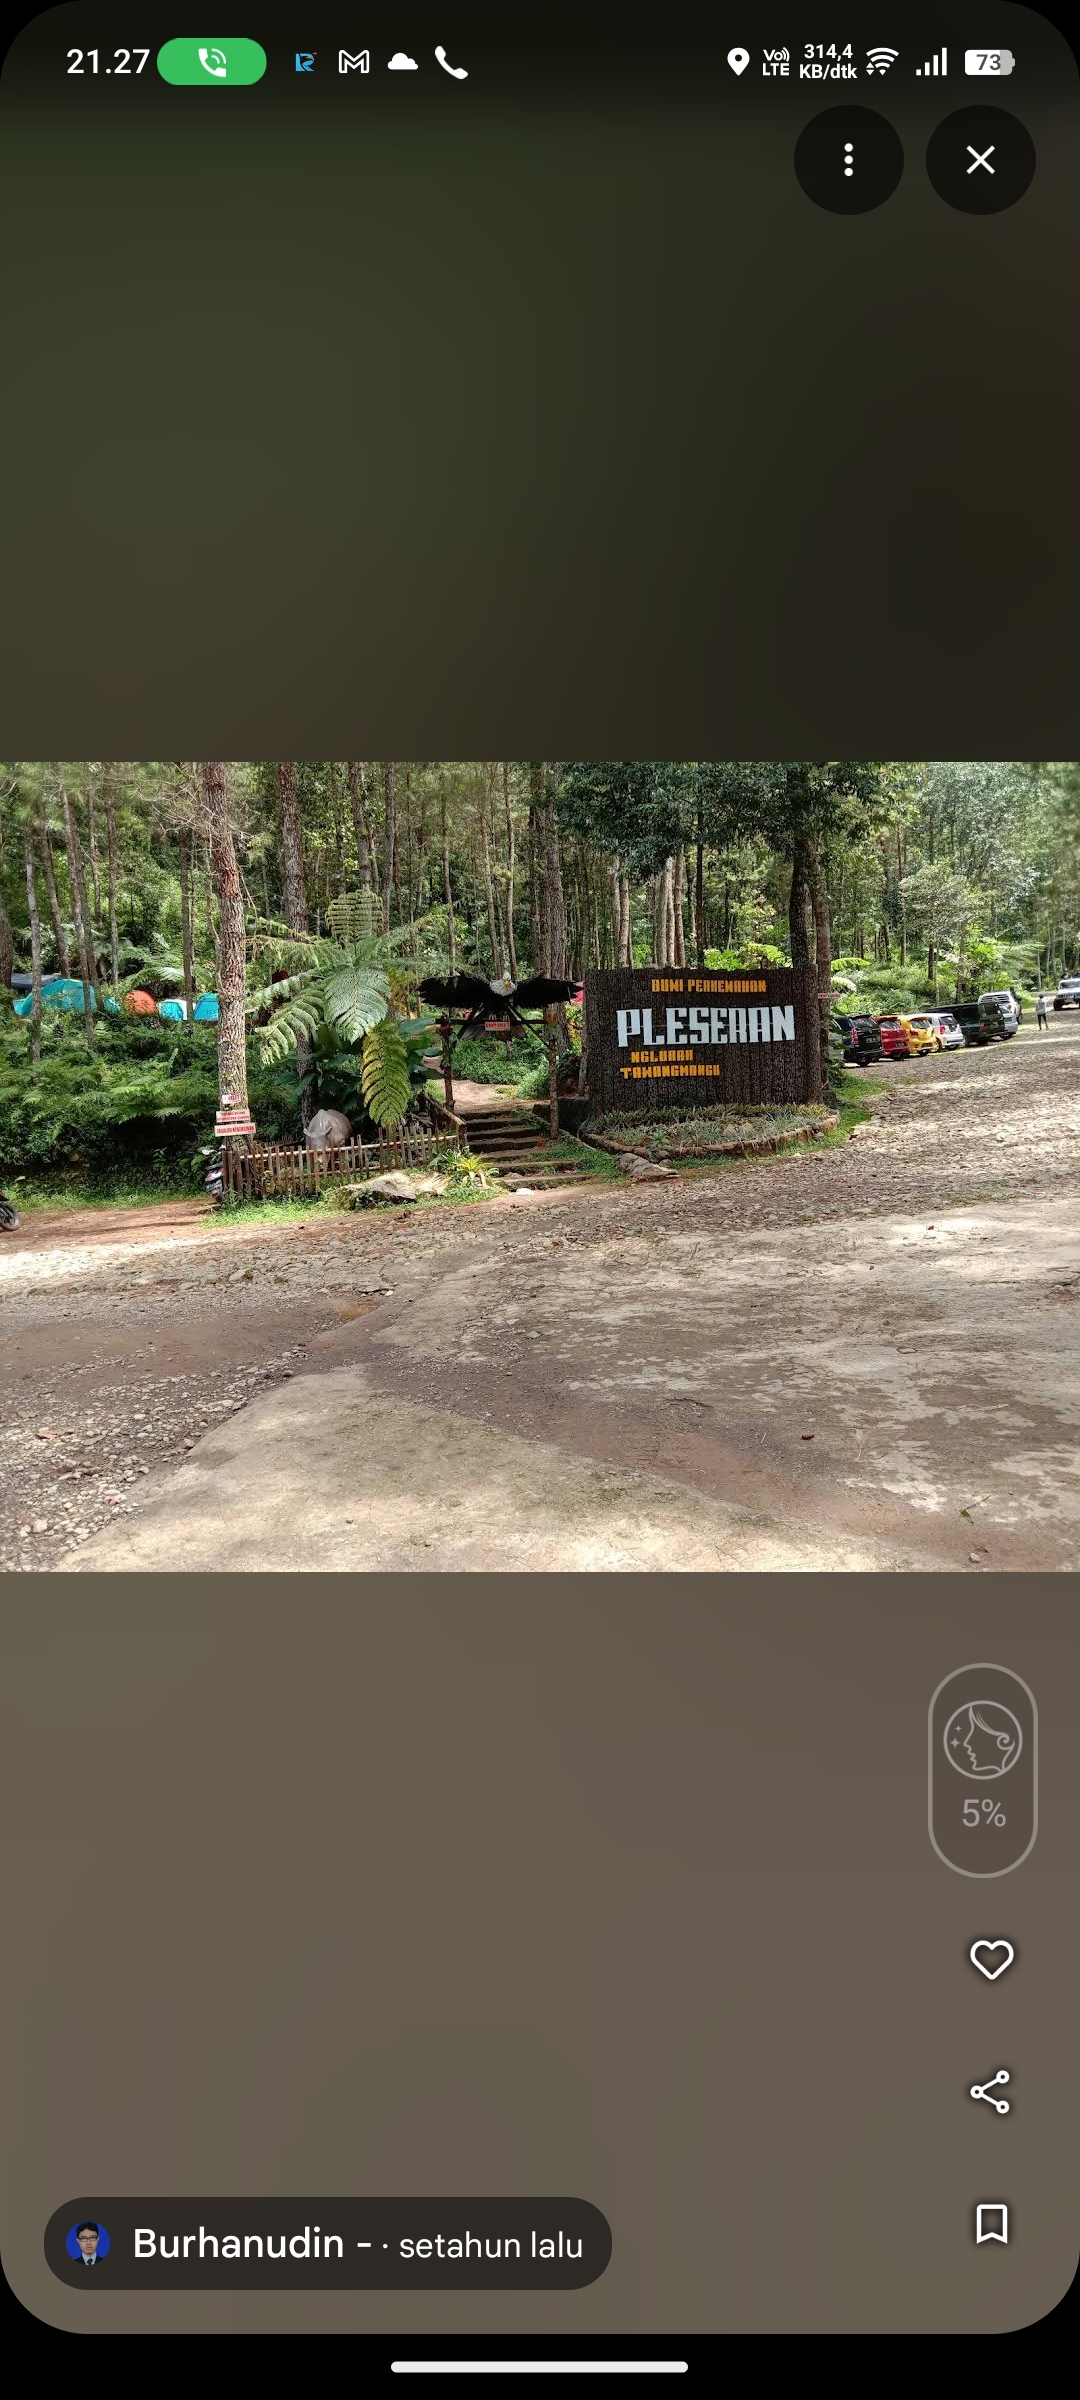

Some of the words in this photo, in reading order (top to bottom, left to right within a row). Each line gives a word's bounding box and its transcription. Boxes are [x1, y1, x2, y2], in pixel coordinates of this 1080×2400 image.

[651, 979, 684, 993] BUMI
[616, 1005, 796, 1048] PLESERAN
[620, 1065, 721, 1079] TAWANGMANGU
